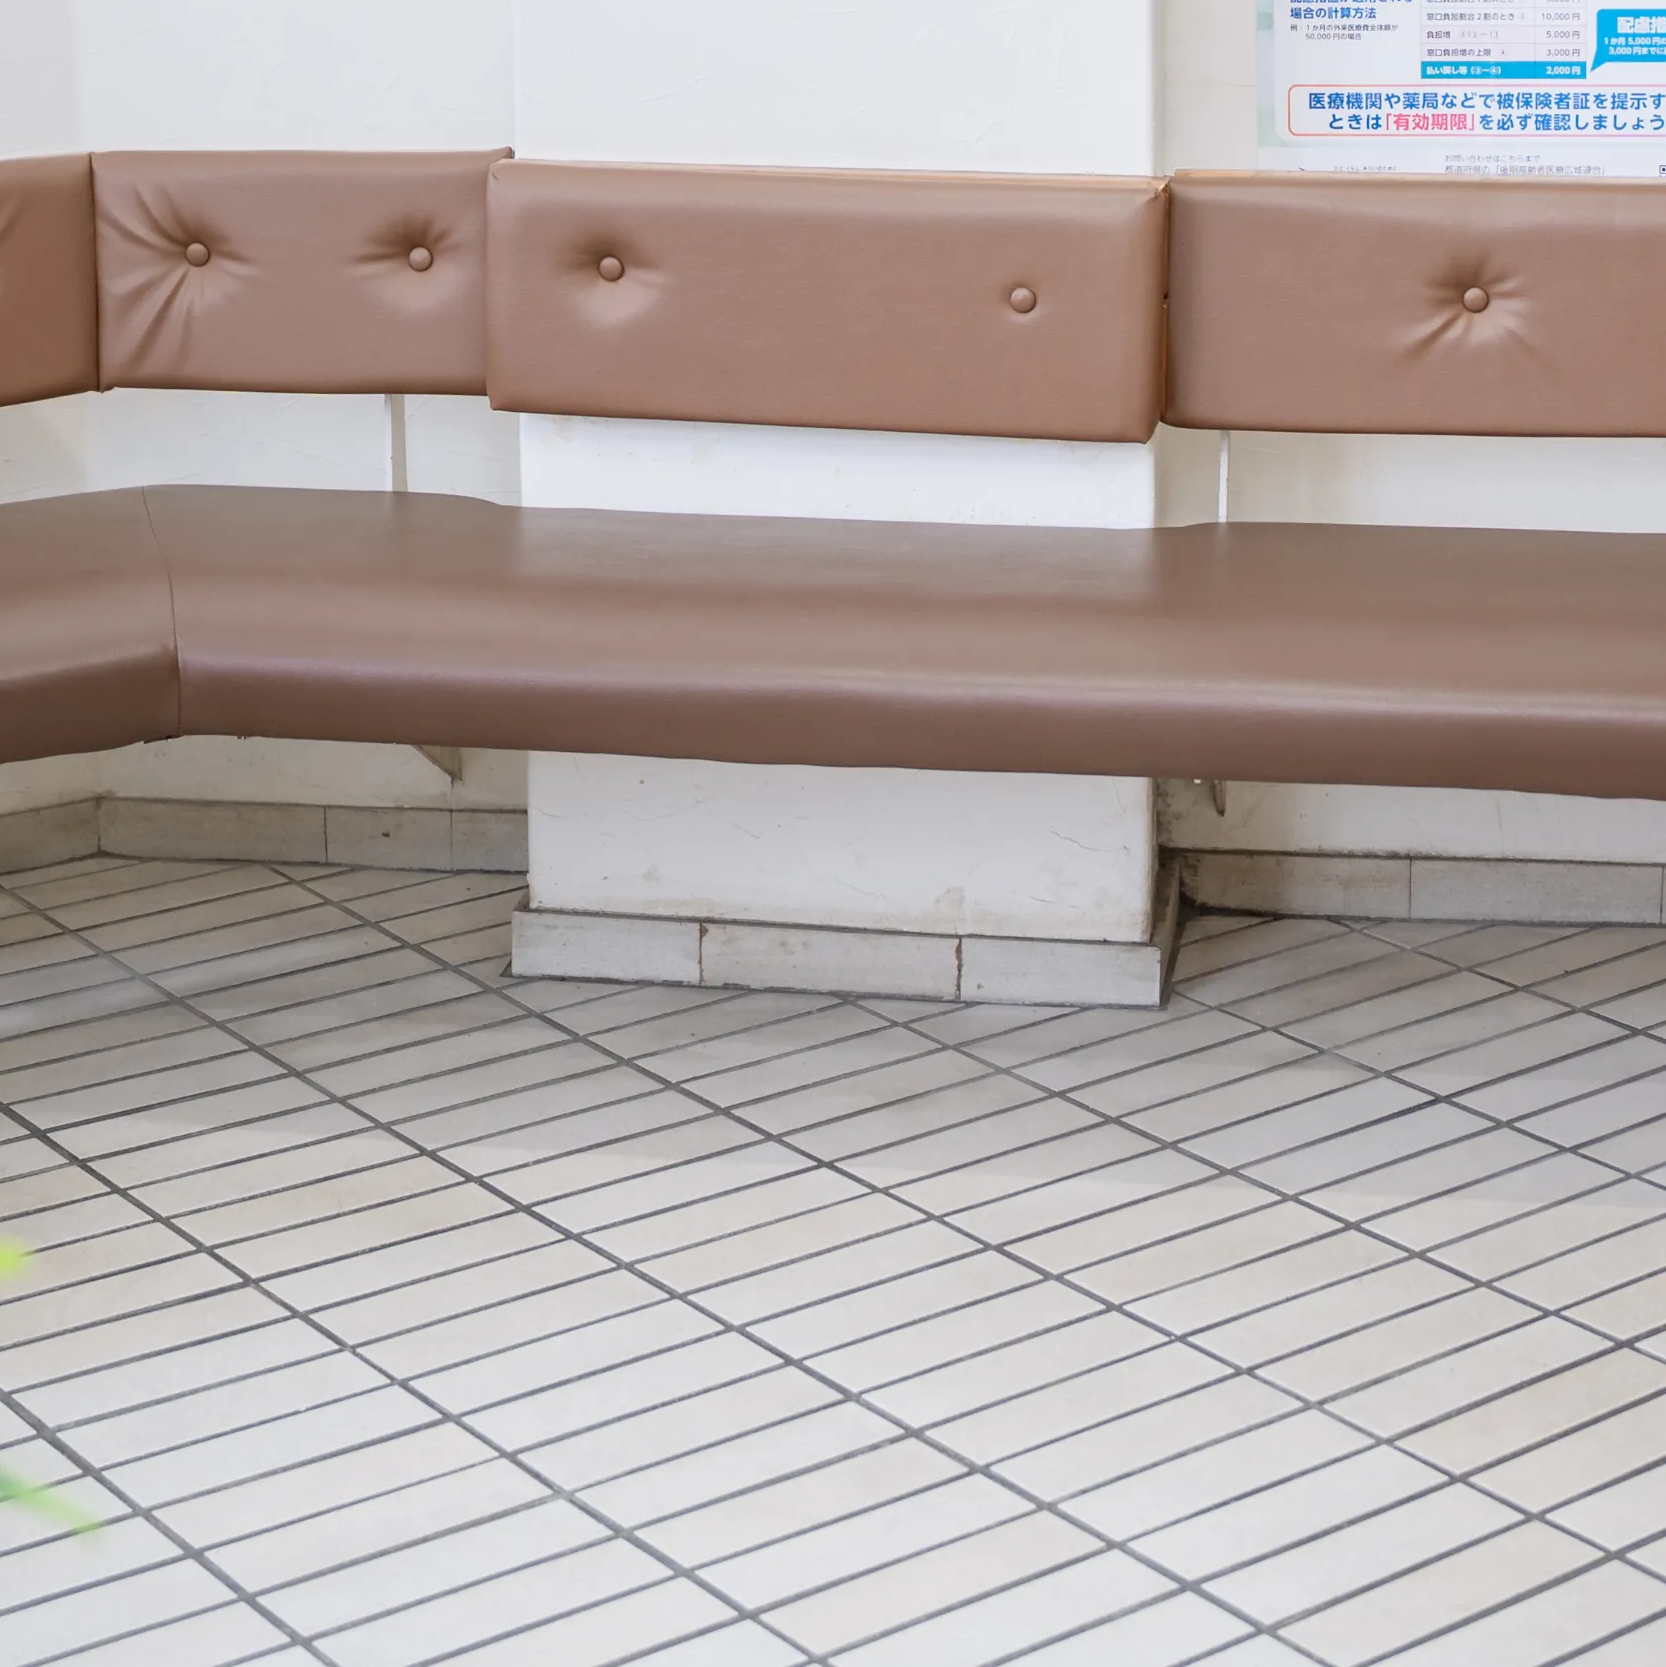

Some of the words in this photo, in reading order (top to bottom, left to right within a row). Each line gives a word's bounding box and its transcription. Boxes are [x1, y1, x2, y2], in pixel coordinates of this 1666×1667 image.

[1289, 7, 1377, 20] 場合の計算方法
[1540, 11, 1581, 22] 10,000円
[1426, 29, 1452, 40] 負担増
[1545, 29, 1581, 40] 5,000円
[1426, 47, 1492, 57] 窓口負担増の上限
[1545, 47, 1581, 57] 3,000円
[1545, 65, 1581, 76] 2,000円
[1328, 113, 1665, 132] ときは「有効期限」を必ず確認しましょう
